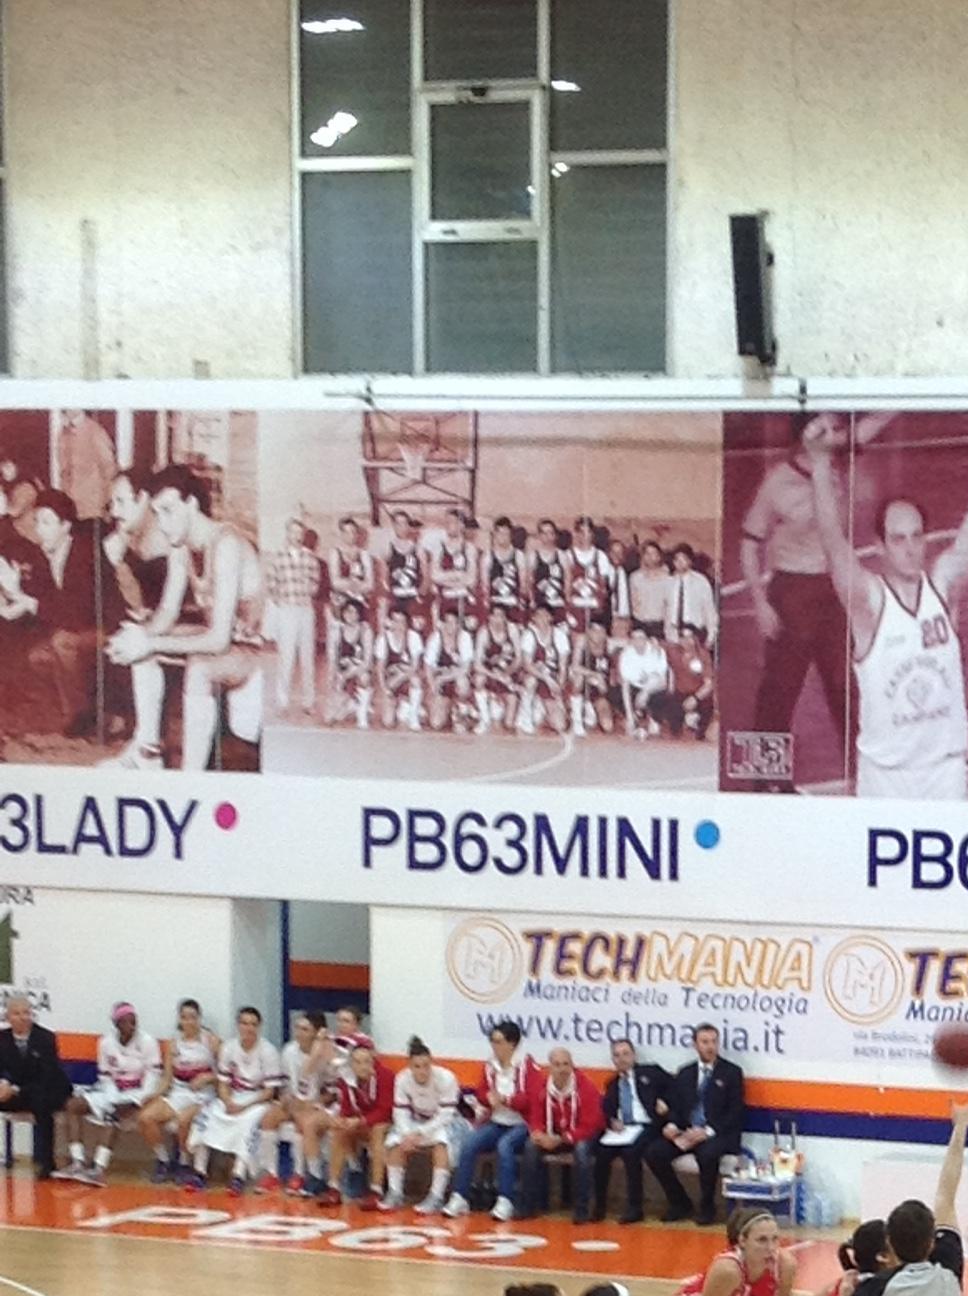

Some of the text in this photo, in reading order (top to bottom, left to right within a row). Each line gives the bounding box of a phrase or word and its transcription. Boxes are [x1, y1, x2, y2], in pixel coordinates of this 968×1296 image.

[361, 805, 680, 882] PB63MINI
[521, 928, 814, 991] TECHMANIA
[524, 980, 809, 1018] Maniaci della Tecnologia
[477, 1011, 786, 1055] www.techmaia.it
[77, 1205, 548, 1258] PB63
